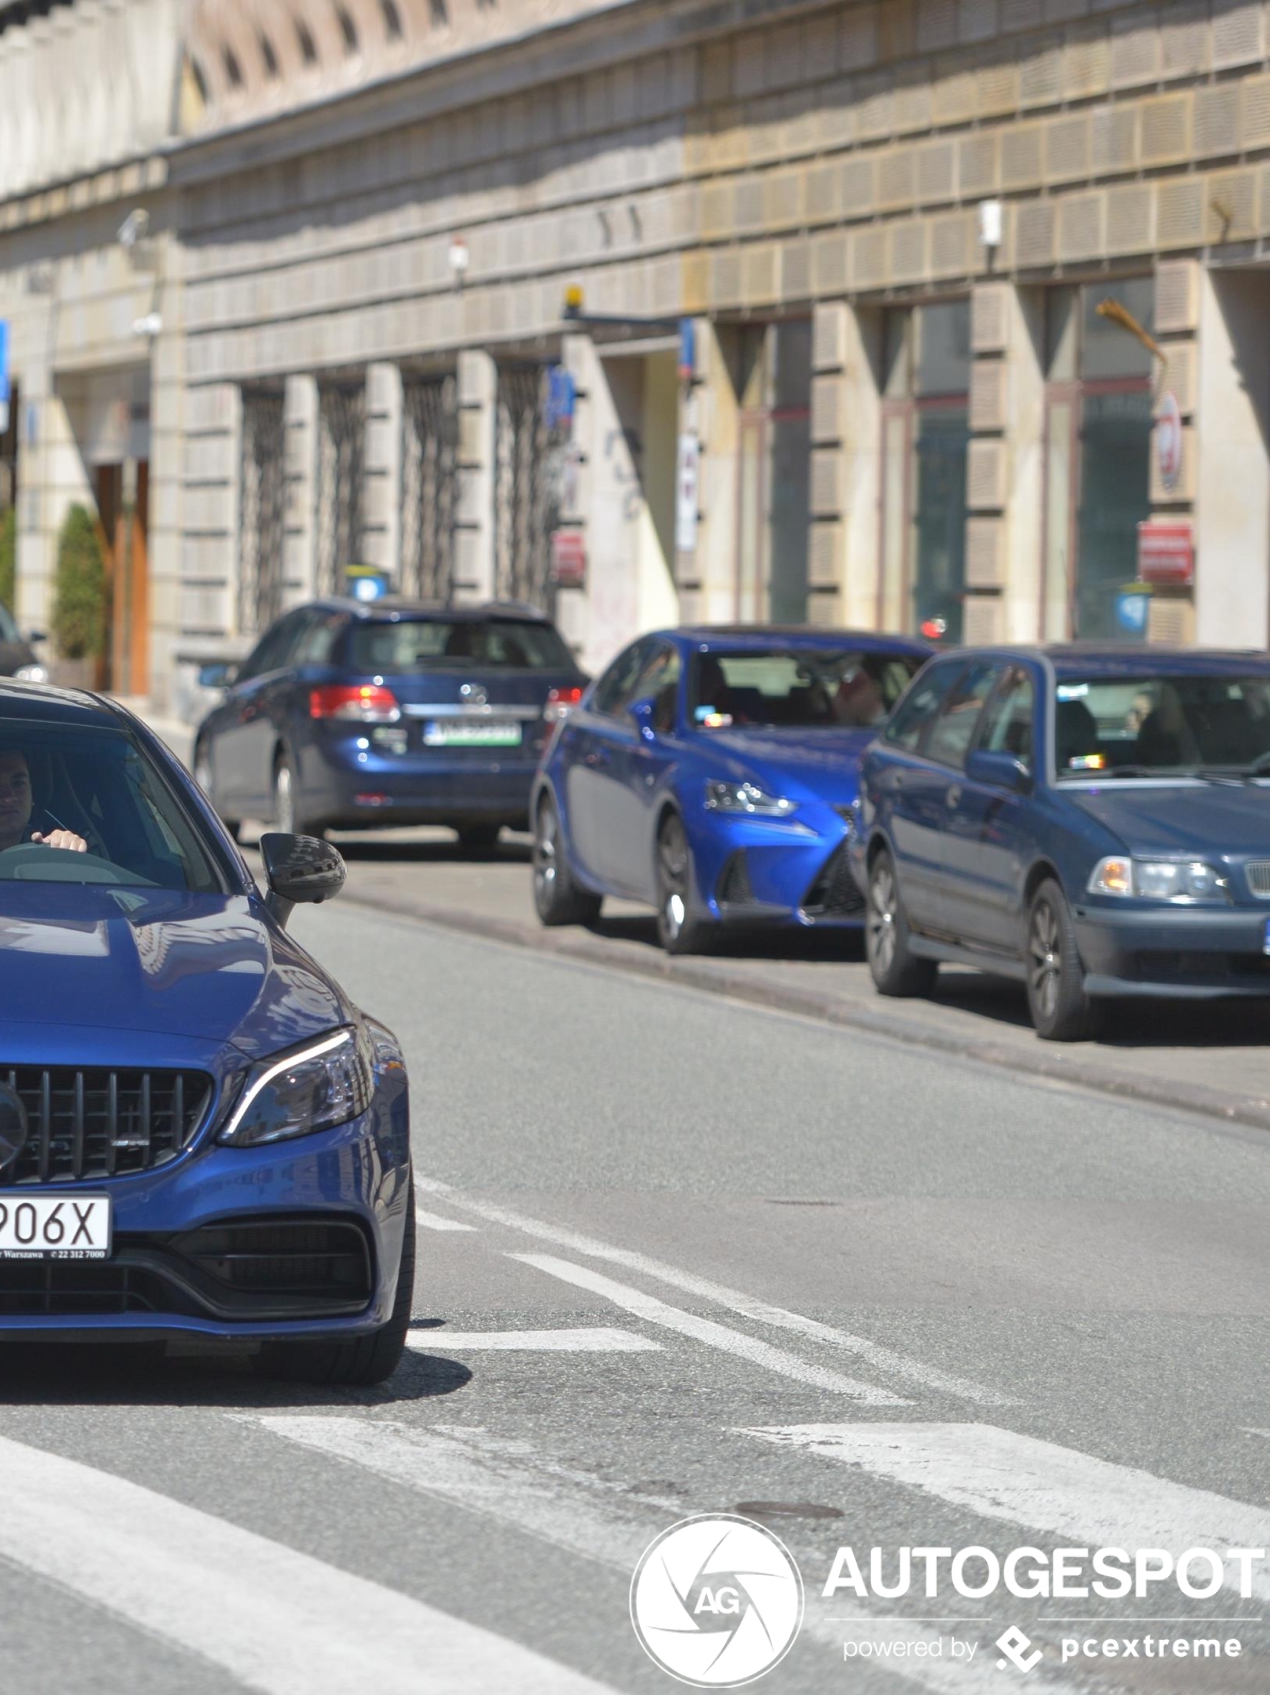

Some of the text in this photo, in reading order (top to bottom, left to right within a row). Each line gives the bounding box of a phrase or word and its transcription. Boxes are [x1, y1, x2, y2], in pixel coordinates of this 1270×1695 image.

[3, 1250, 43, 1259] Warszawa
[58, 1250, 68, 1259] 22
[70, 1250, 84, 1259] 312
[85, 1250, 105, 1259] 7000
